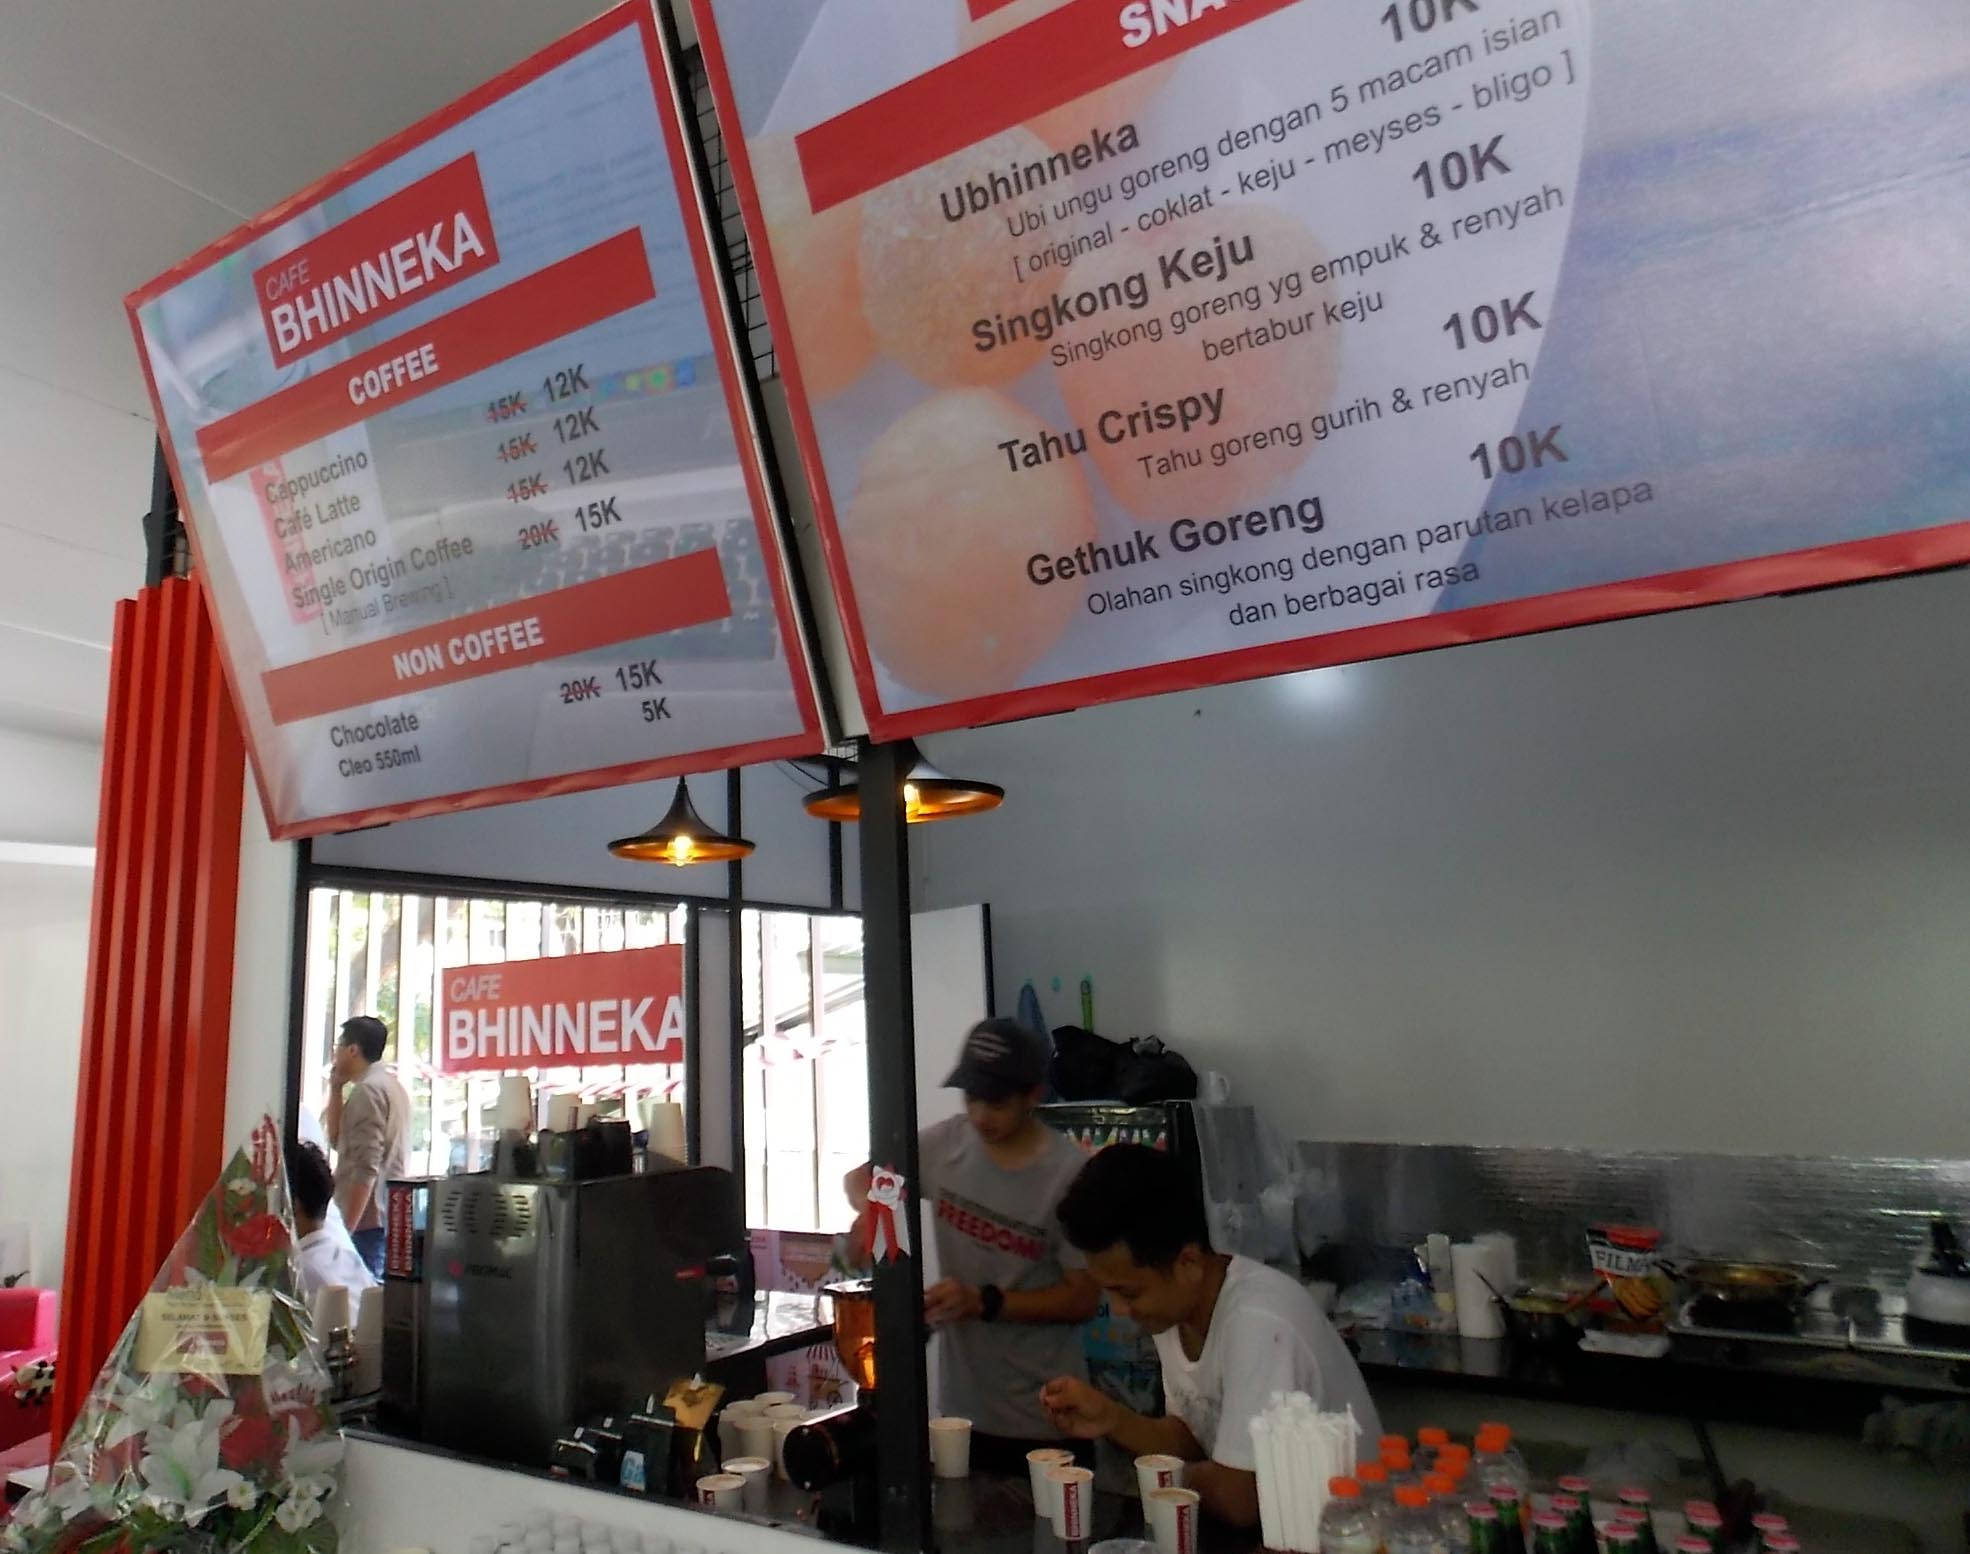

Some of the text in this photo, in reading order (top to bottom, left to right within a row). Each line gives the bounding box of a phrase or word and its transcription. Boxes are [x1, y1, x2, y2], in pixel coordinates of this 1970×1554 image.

[1007, 6, 1562, 239] Ubi ungu goreng dengan 5 macam isian
[940, 123, 1141, 224] Ubhinneka
[1029, 221, 1113, 273] original
[1137, 184, 1214, 232] coklat
[1238, 157, 1296, 196] keju
[1324, 104, 1443, 165] meyses
[1472, 63, 1553, 110] bligo
[1411, 134, 1512, 200] 10K
[265, 258, 311, 301] CAFE
[271, 211, 486, 353] BHINNEKA
[971, 234, 1255, 353] Singkong Keju
[1051, 184, 1564, 368] Singkong goreng yg empuk & renyah
[1202, 289, 1384, 362] bertabur keju
[1442, 290, 1543, 351] 10K
[348, 343, 440, 406] COFFEE
[543, 363, 590, 403] 12K
[553, 406, 600, 444] 12K
[997, 387, 1225, 473] Tahu Crispy
[1137, 357, 1531, 479] Tahu goreng gurih & renyah
[264, 450, 369, 505] Cappuccino
[507, 448, 610, 504] 15K 12K
[1469, 424, 1569, 480] 10K
[273, 493, 362, 540] Café Latte
[518, 496, 622, 550] 20K 15K
[1026, 496, 1325, 586] Gethuk Goreng
[1087, 480, 1655, 615] Olahan singkong dengan parutan kelapa
[284, 528, 377, 575] Americano
[291, 535, 475, 609] Single Origin Coffee
[329, 599, 381, 628] Manual
[1229, 562, 1480, 626] dan berbagai rasa
[393, 617, 545, 681] NON COFFEE
[559, 659, 664, 704] 20K 15K
[641, 697, 672, 723] 5K
[329, 711, 421, 748] Chocolate
[338, 745, 422, 779] Cleo 550ml
[450, 973, 503, 1003] CAFE
[449, 995, 686, 1060] BHINNEKA
